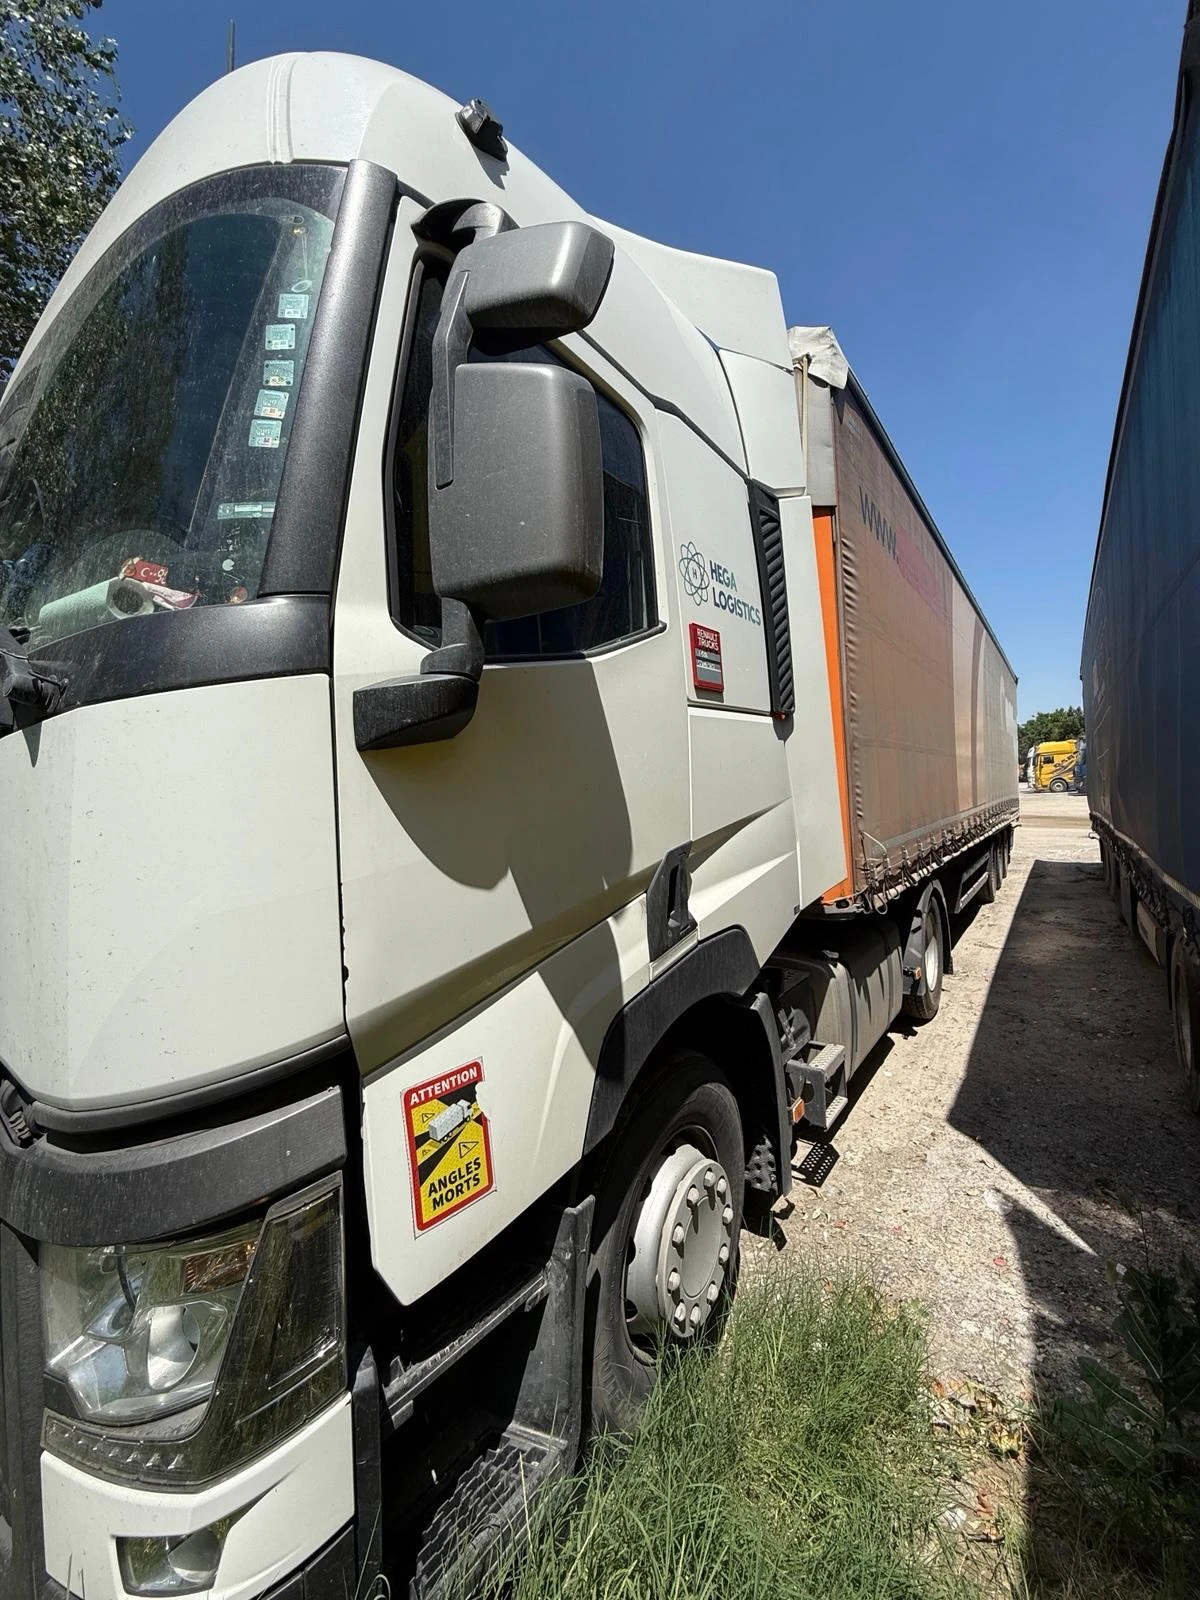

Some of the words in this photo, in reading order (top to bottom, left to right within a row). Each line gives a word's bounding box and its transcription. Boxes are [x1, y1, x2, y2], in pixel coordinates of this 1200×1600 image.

[709, 560, 737, 592] HEGA
[712, 587, 761, 626] LOGISTICS
[696, 628, 718, 642] RENAULT
[697, 637, 719, 651] TRUCKS
[410, 1066, 478, 1105] ATTENTION
[428, 1157, 481, 1197] ANGLES
[432, 1173, 481, 1211] MORTS
